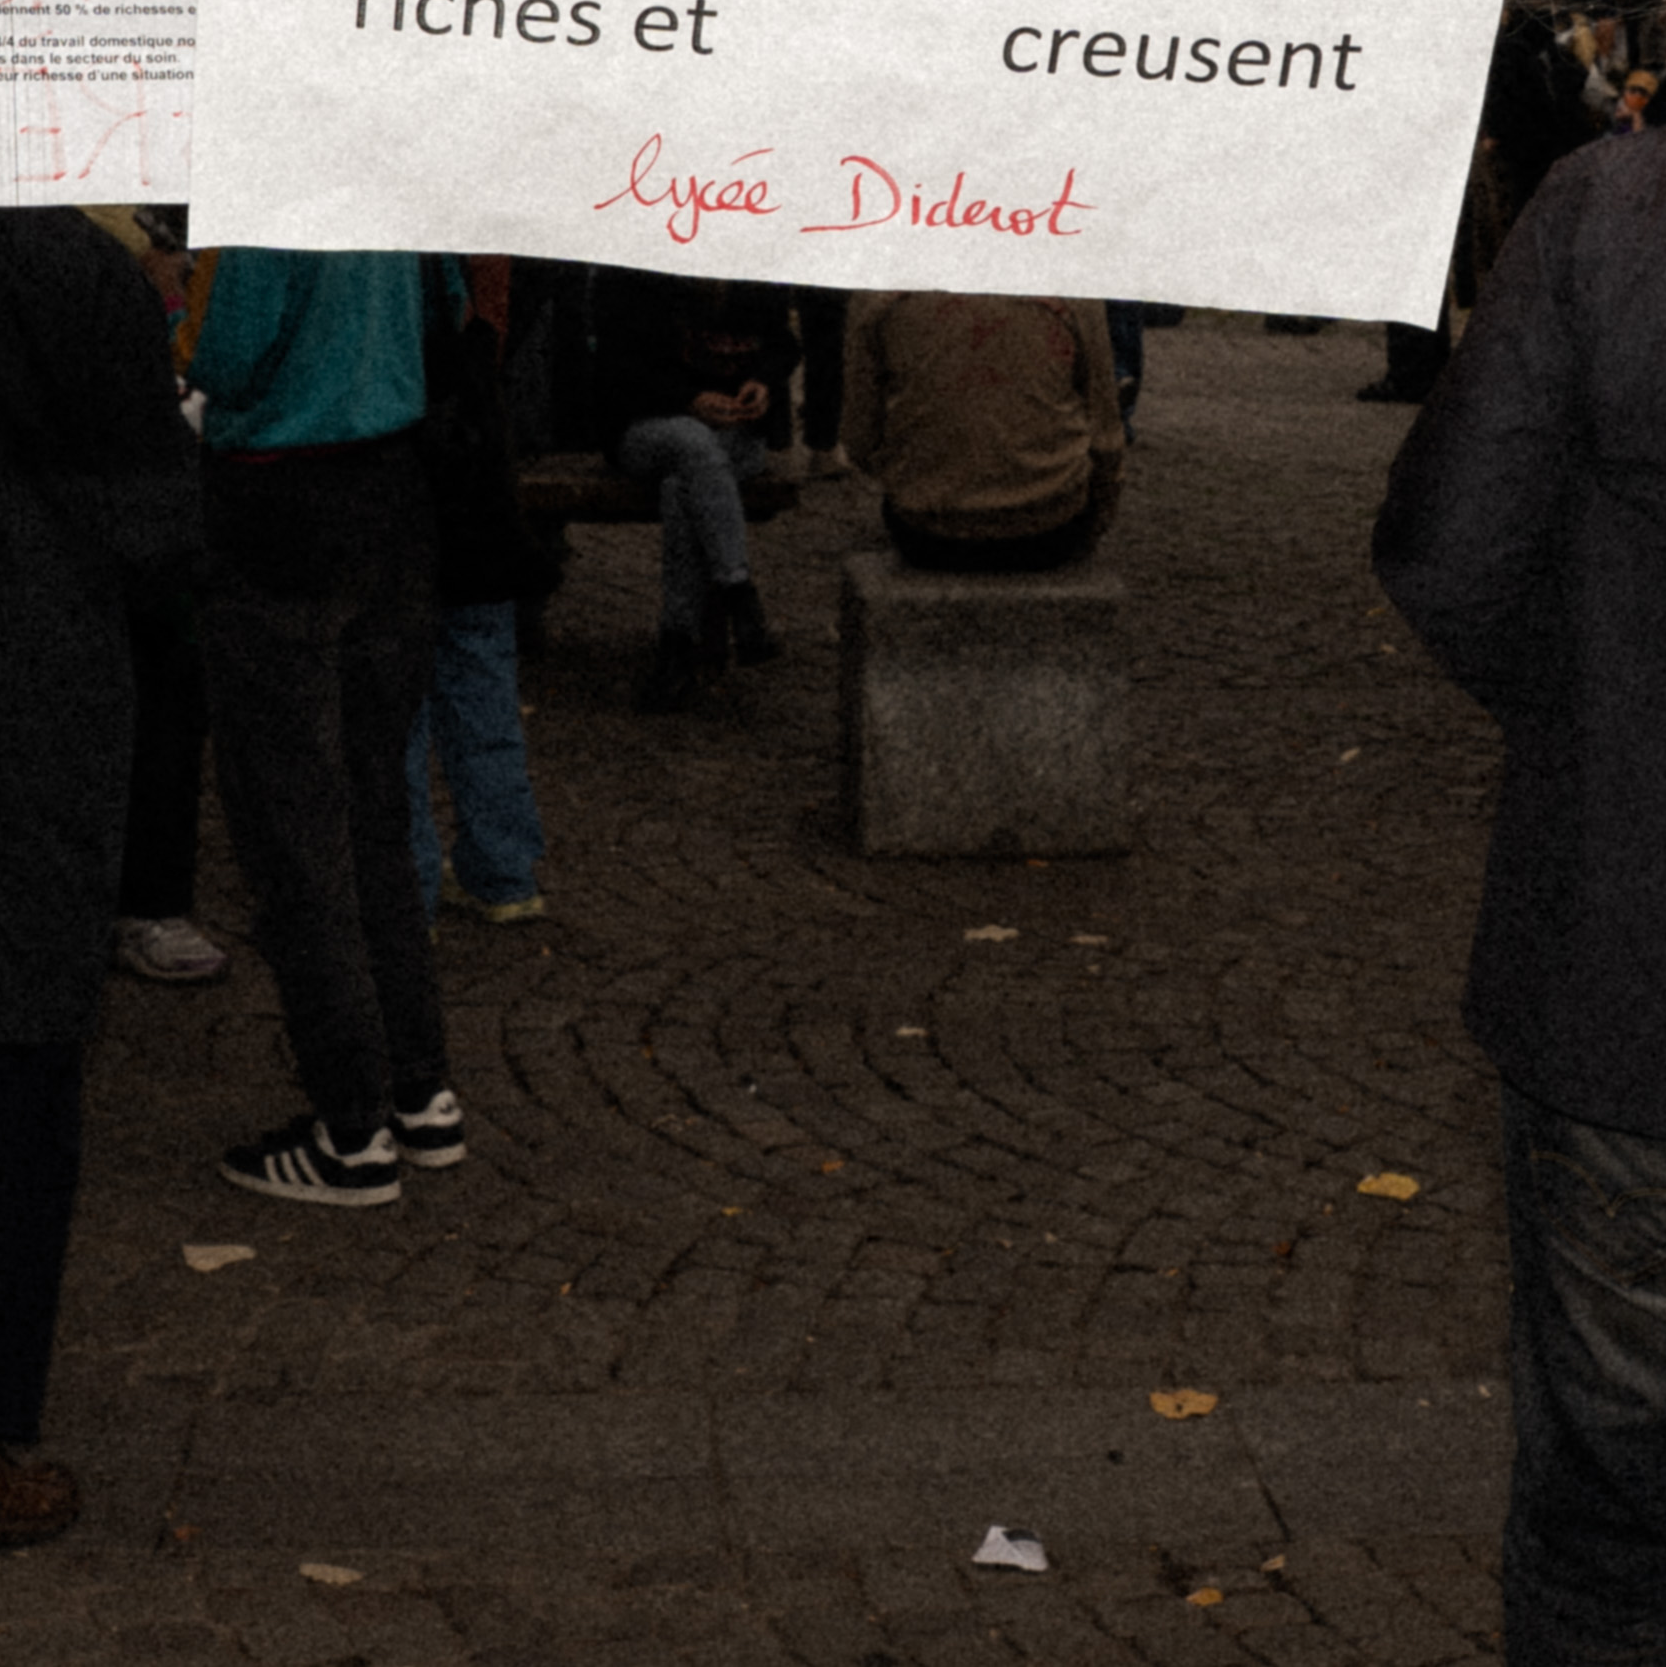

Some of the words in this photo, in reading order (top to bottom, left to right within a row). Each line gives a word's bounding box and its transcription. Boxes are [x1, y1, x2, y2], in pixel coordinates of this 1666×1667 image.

[55, 2, 72, 15] 50
[75, 2, 89, 15] %
[92, 2, 111, 15] de
[114, 2, 184, 15] richesses
[40, 34, 85, 47] travail
[89, 34, 173, 50] domestique
[10, 51, 45, 64] dans
[50, 51, 62, 64] le
[66, 51, 119, 64] secteur
[1003, 27, 1361, 90] creusent
[23, 68, 83, 81] richesse
[87, 68, 128, 81] d'une
[131, 68, 195, 81] situation
[800, 155, 1095, 237] Diderot
